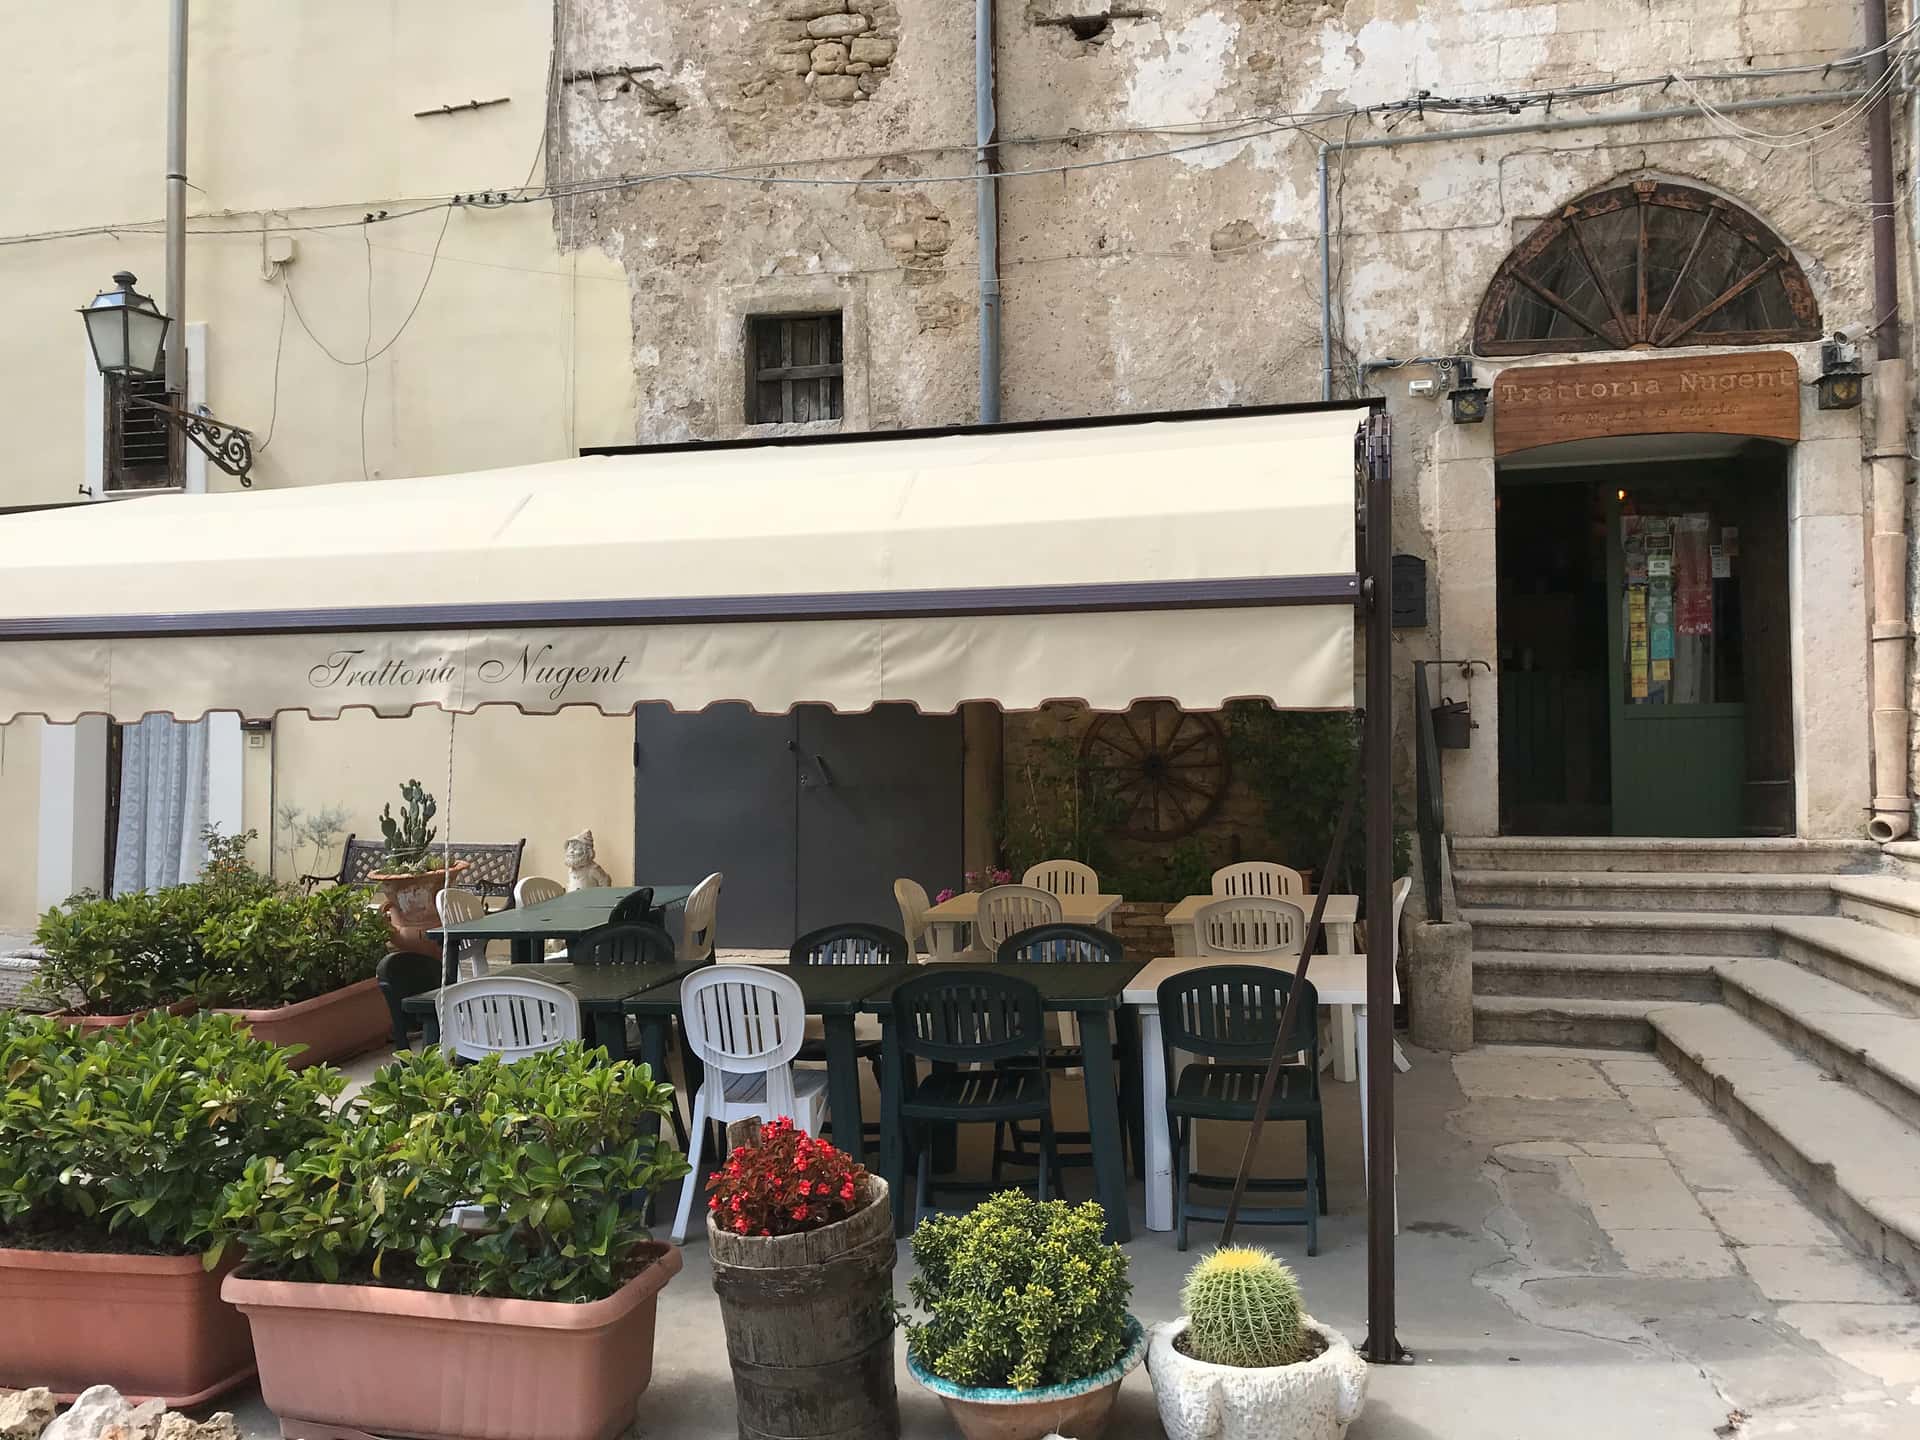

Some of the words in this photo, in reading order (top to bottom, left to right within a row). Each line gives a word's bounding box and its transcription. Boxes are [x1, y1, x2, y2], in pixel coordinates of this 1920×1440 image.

[1502, 377, 1662, 402] Trattoria
[1679, 367, 1795, 396] Nugent
[307, 649, 456, 689] Trattoria
[477, 644, 631, 701] Nugent
